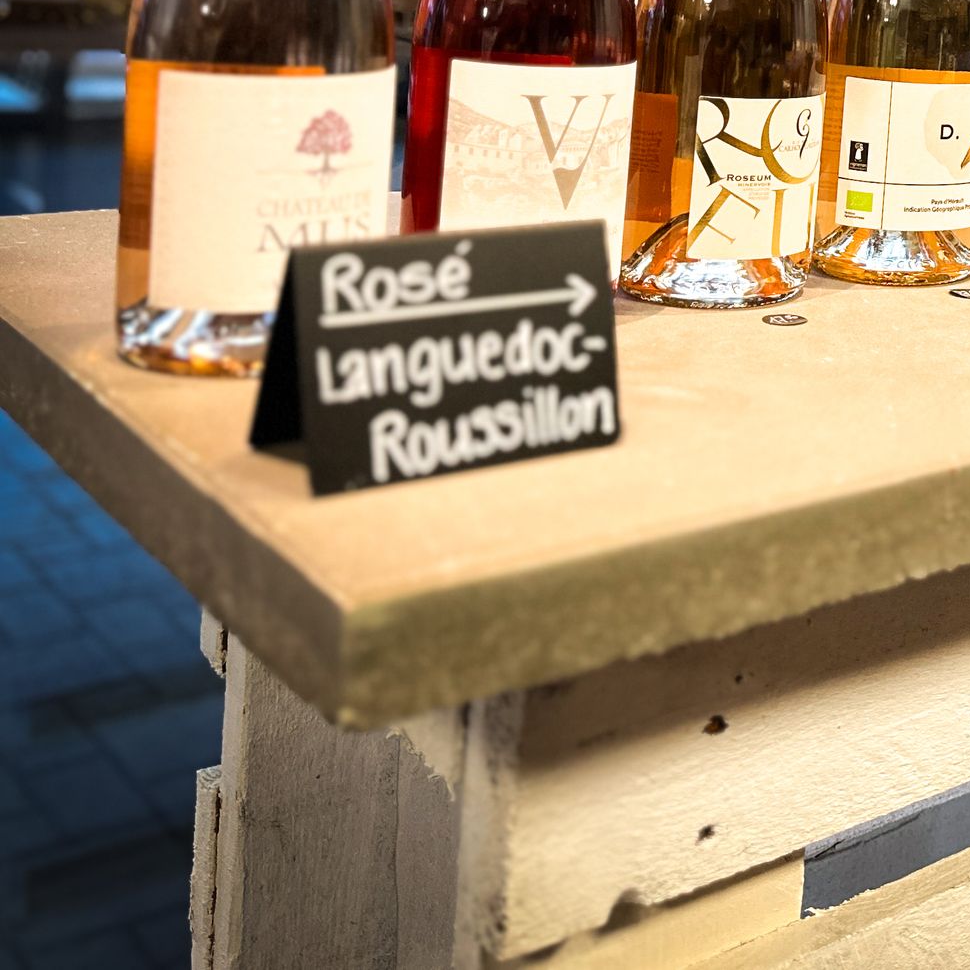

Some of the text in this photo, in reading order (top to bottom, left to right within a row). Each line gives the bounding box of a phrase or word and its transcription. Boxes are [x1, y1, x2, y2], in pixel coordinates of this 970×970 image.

[321, 239, 472, 312] Rosé
[316, 319, 607, 408] Languedoc-
[369, 383, 616, 483] Roussillon
